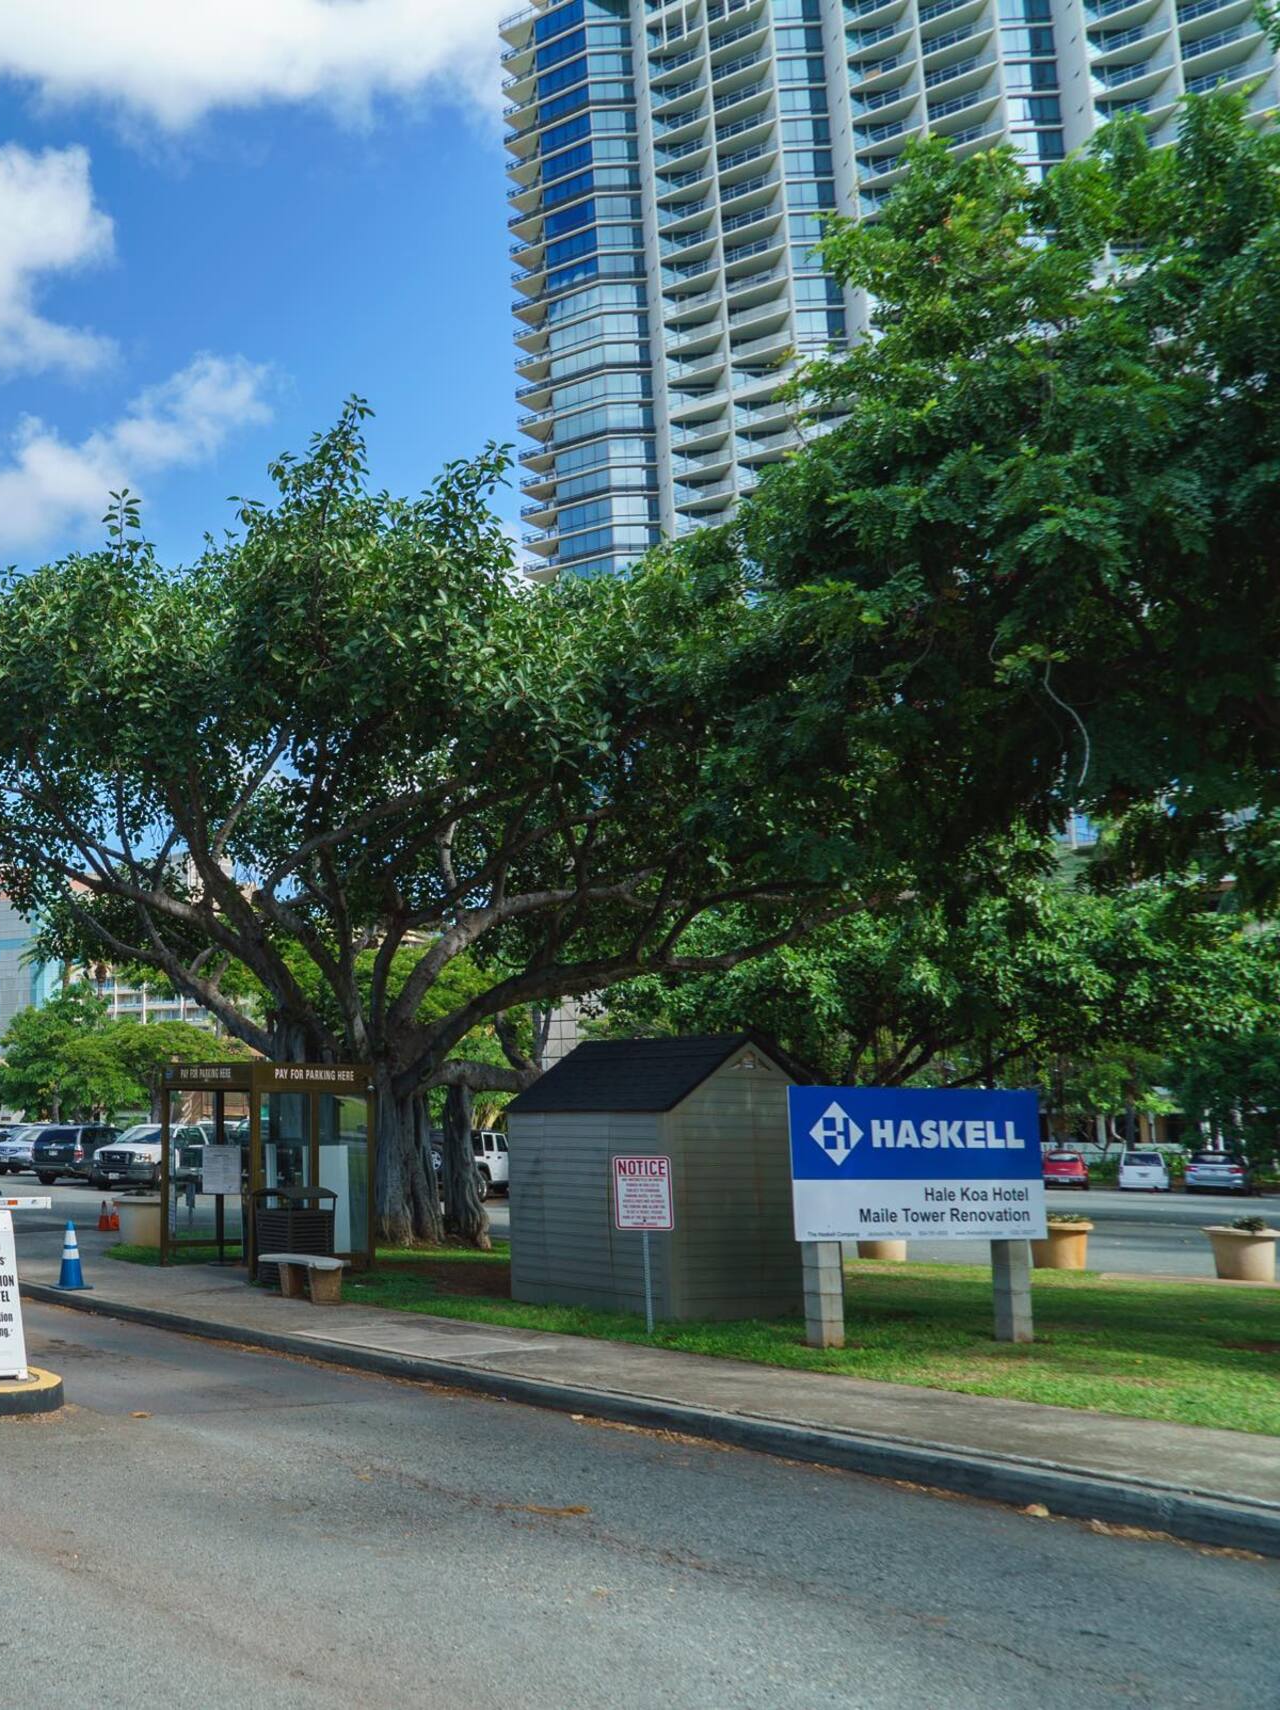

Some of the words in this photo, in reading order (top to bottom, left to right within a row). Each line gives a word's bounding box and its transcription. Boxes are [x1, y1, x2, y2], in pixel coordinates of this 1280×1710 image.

[180, 1068, 189, 1079] PAY
[190, 1068, 198, 1079] FOR
[199, 1068, 219, 1079] PARKING
[220, 1068, 231, 1079] HERE
[275, 1069, 288, 1080] PAY
[290, 1069, 304, 1080] FOR
[305, 1069, 336, 1081] PARKING
[337, 1070, 355, 1082] HERE
[870, 1119, 1025, 1149] HASKELL
[618, 1161, 666, 1175] NOTICE
[924, 1187, 956, 1201] Hale
[961, 1188, 988, 1201] Koa
[993, 1187, 1028, 1201] Hotel
[859, 1208, 898, 1223] Maile
[902, 1208, 945, 1222] Tower
[950, 1207, 1030, 1222] Renovation
